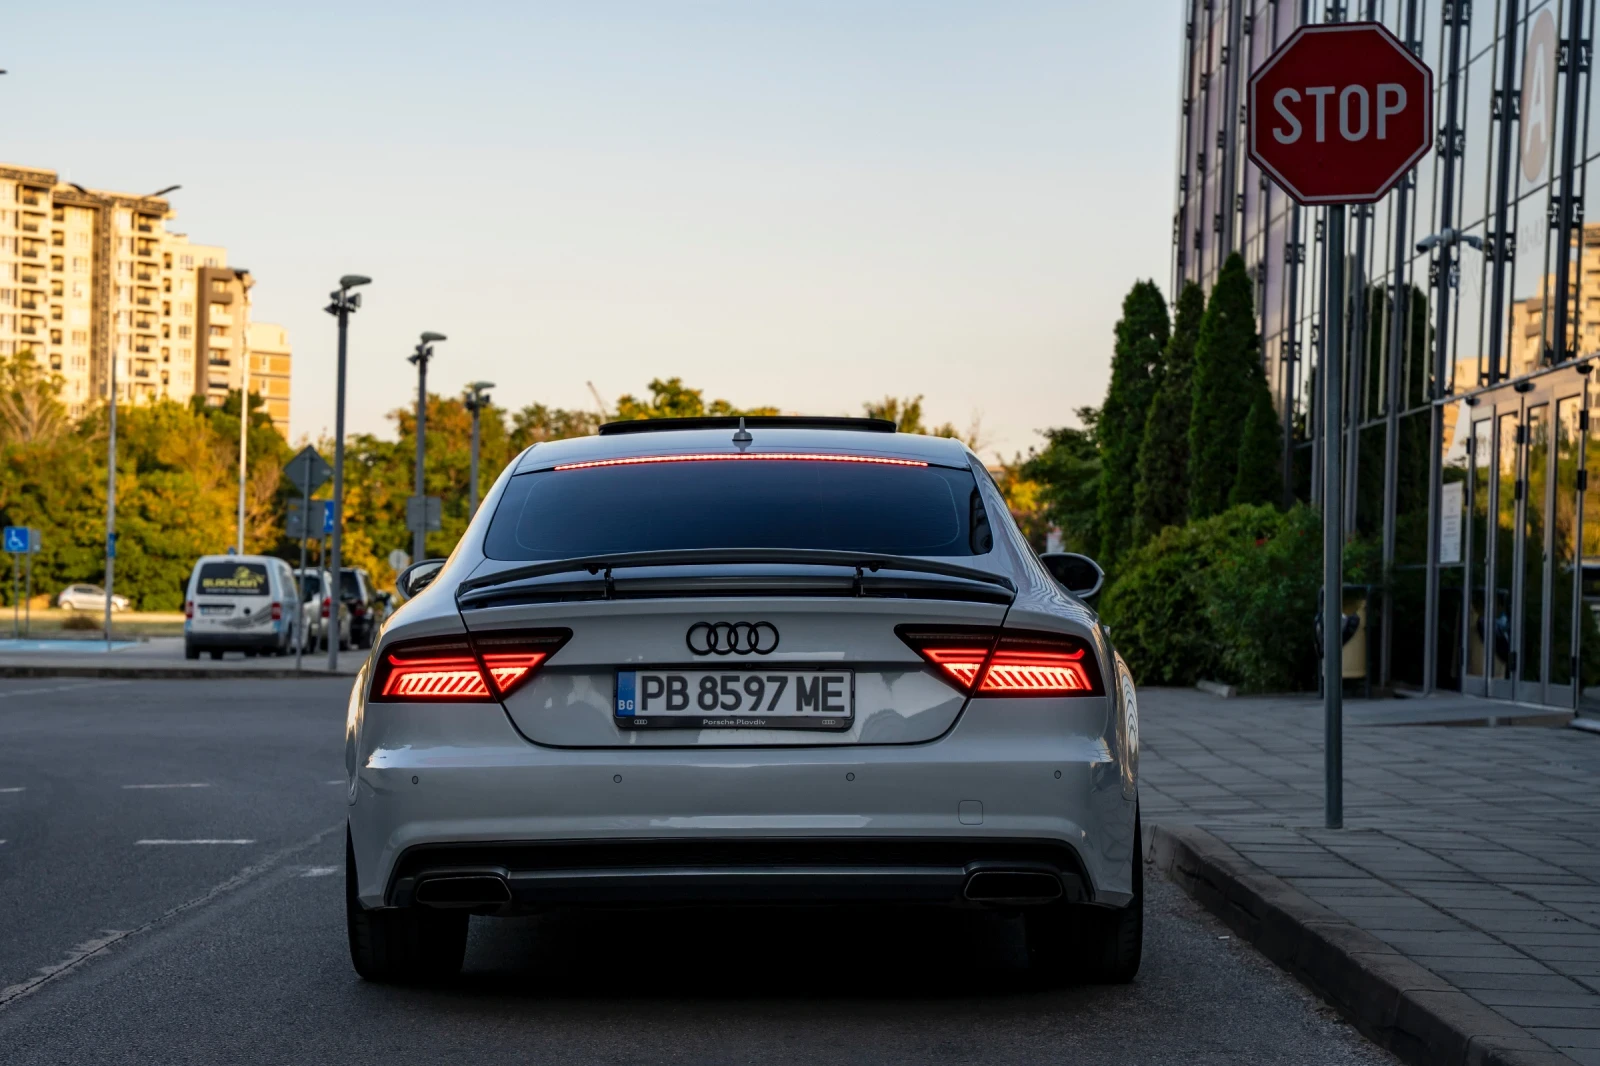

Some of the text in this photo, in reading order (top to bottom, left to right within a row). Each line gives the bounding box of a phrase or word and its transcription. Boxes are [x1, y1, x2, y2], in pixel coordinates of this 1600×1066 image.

[1272, 83, 1407, 145] STOP
[618, 699, 634, 711] BG
[641, 675, 845, 712] PB 8597 ME
[702, 718, 766, 726] Porsche Plovdiv
